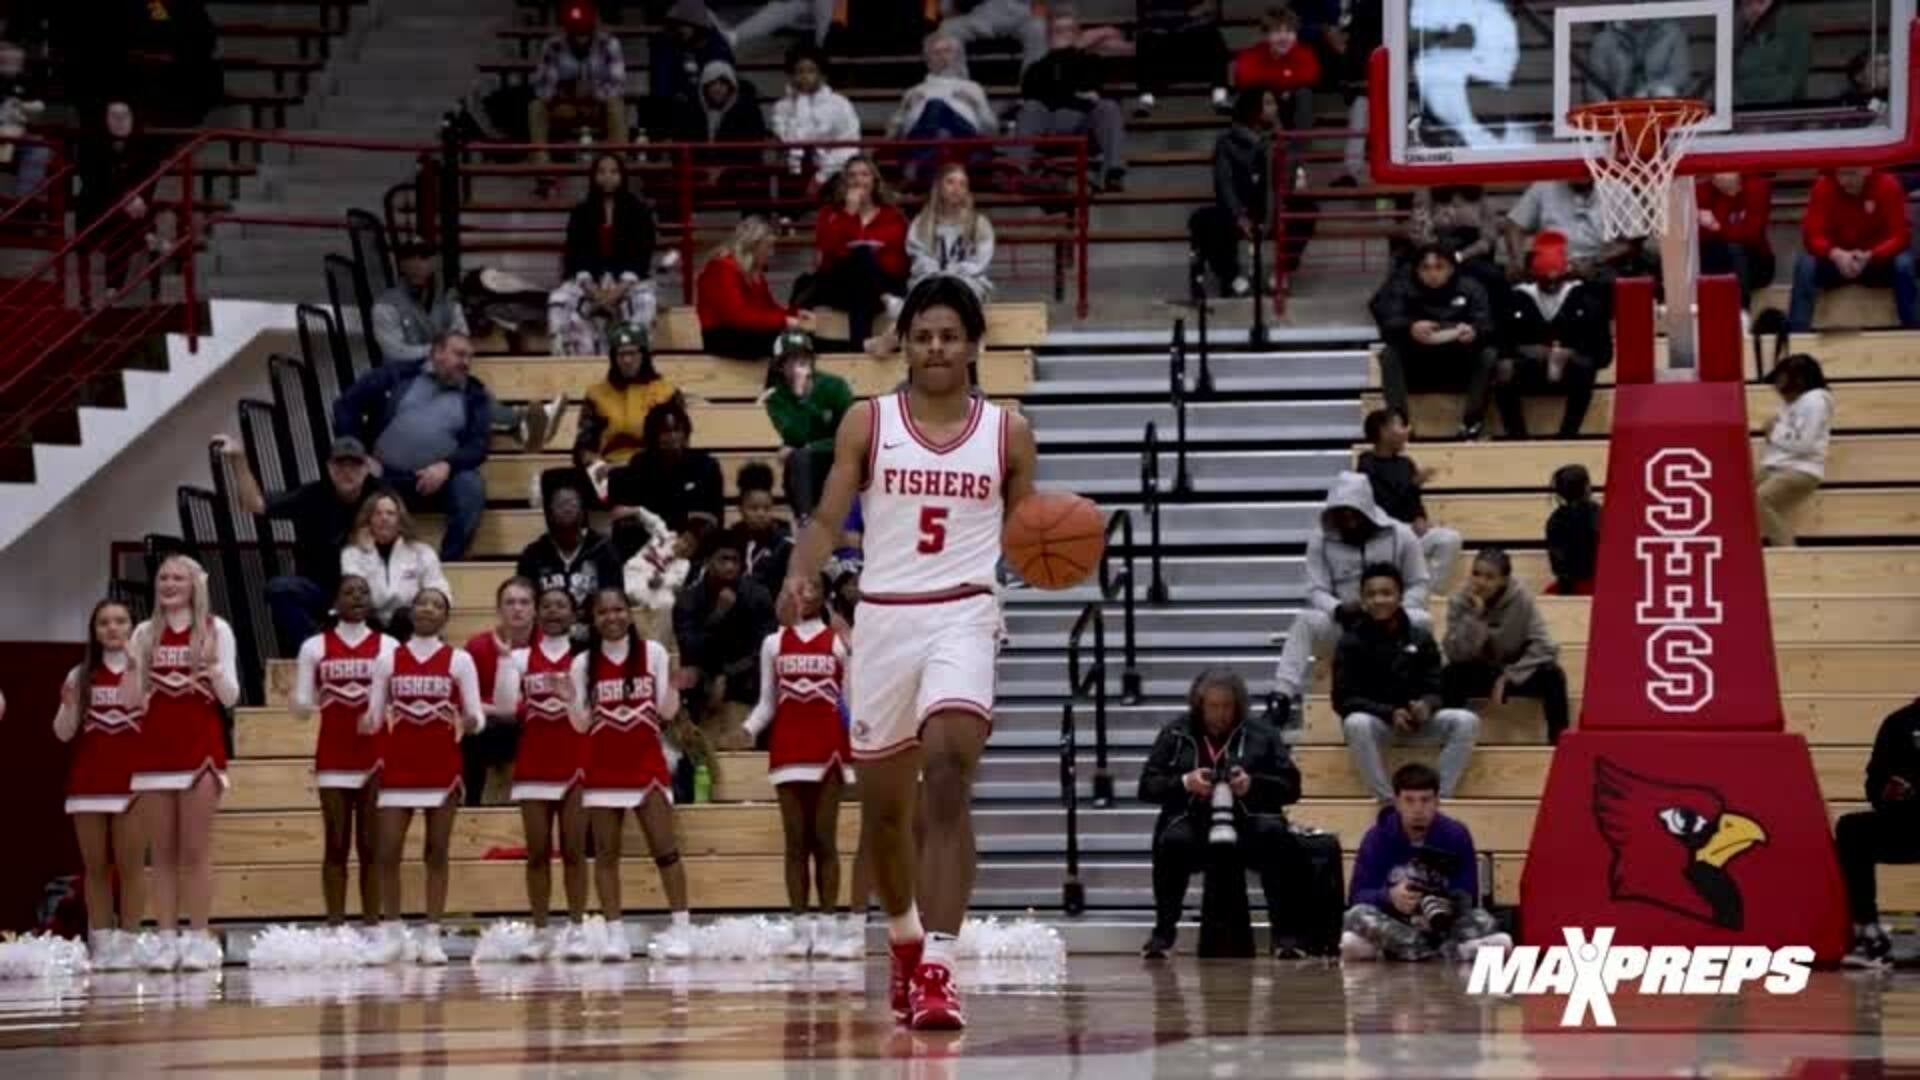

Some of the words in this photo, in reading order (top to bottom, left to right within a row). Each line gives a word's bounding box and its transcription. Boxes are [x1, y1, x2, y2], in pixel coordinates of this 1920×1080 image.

[884, 468, 992, 500] FISHERS
[916, 505, 949, 555] 5
[1636, 447, 1723, 712] SHS
[777, 654, 836, 676] FISHERS
[392, 675, 452, 698] FISHERS
